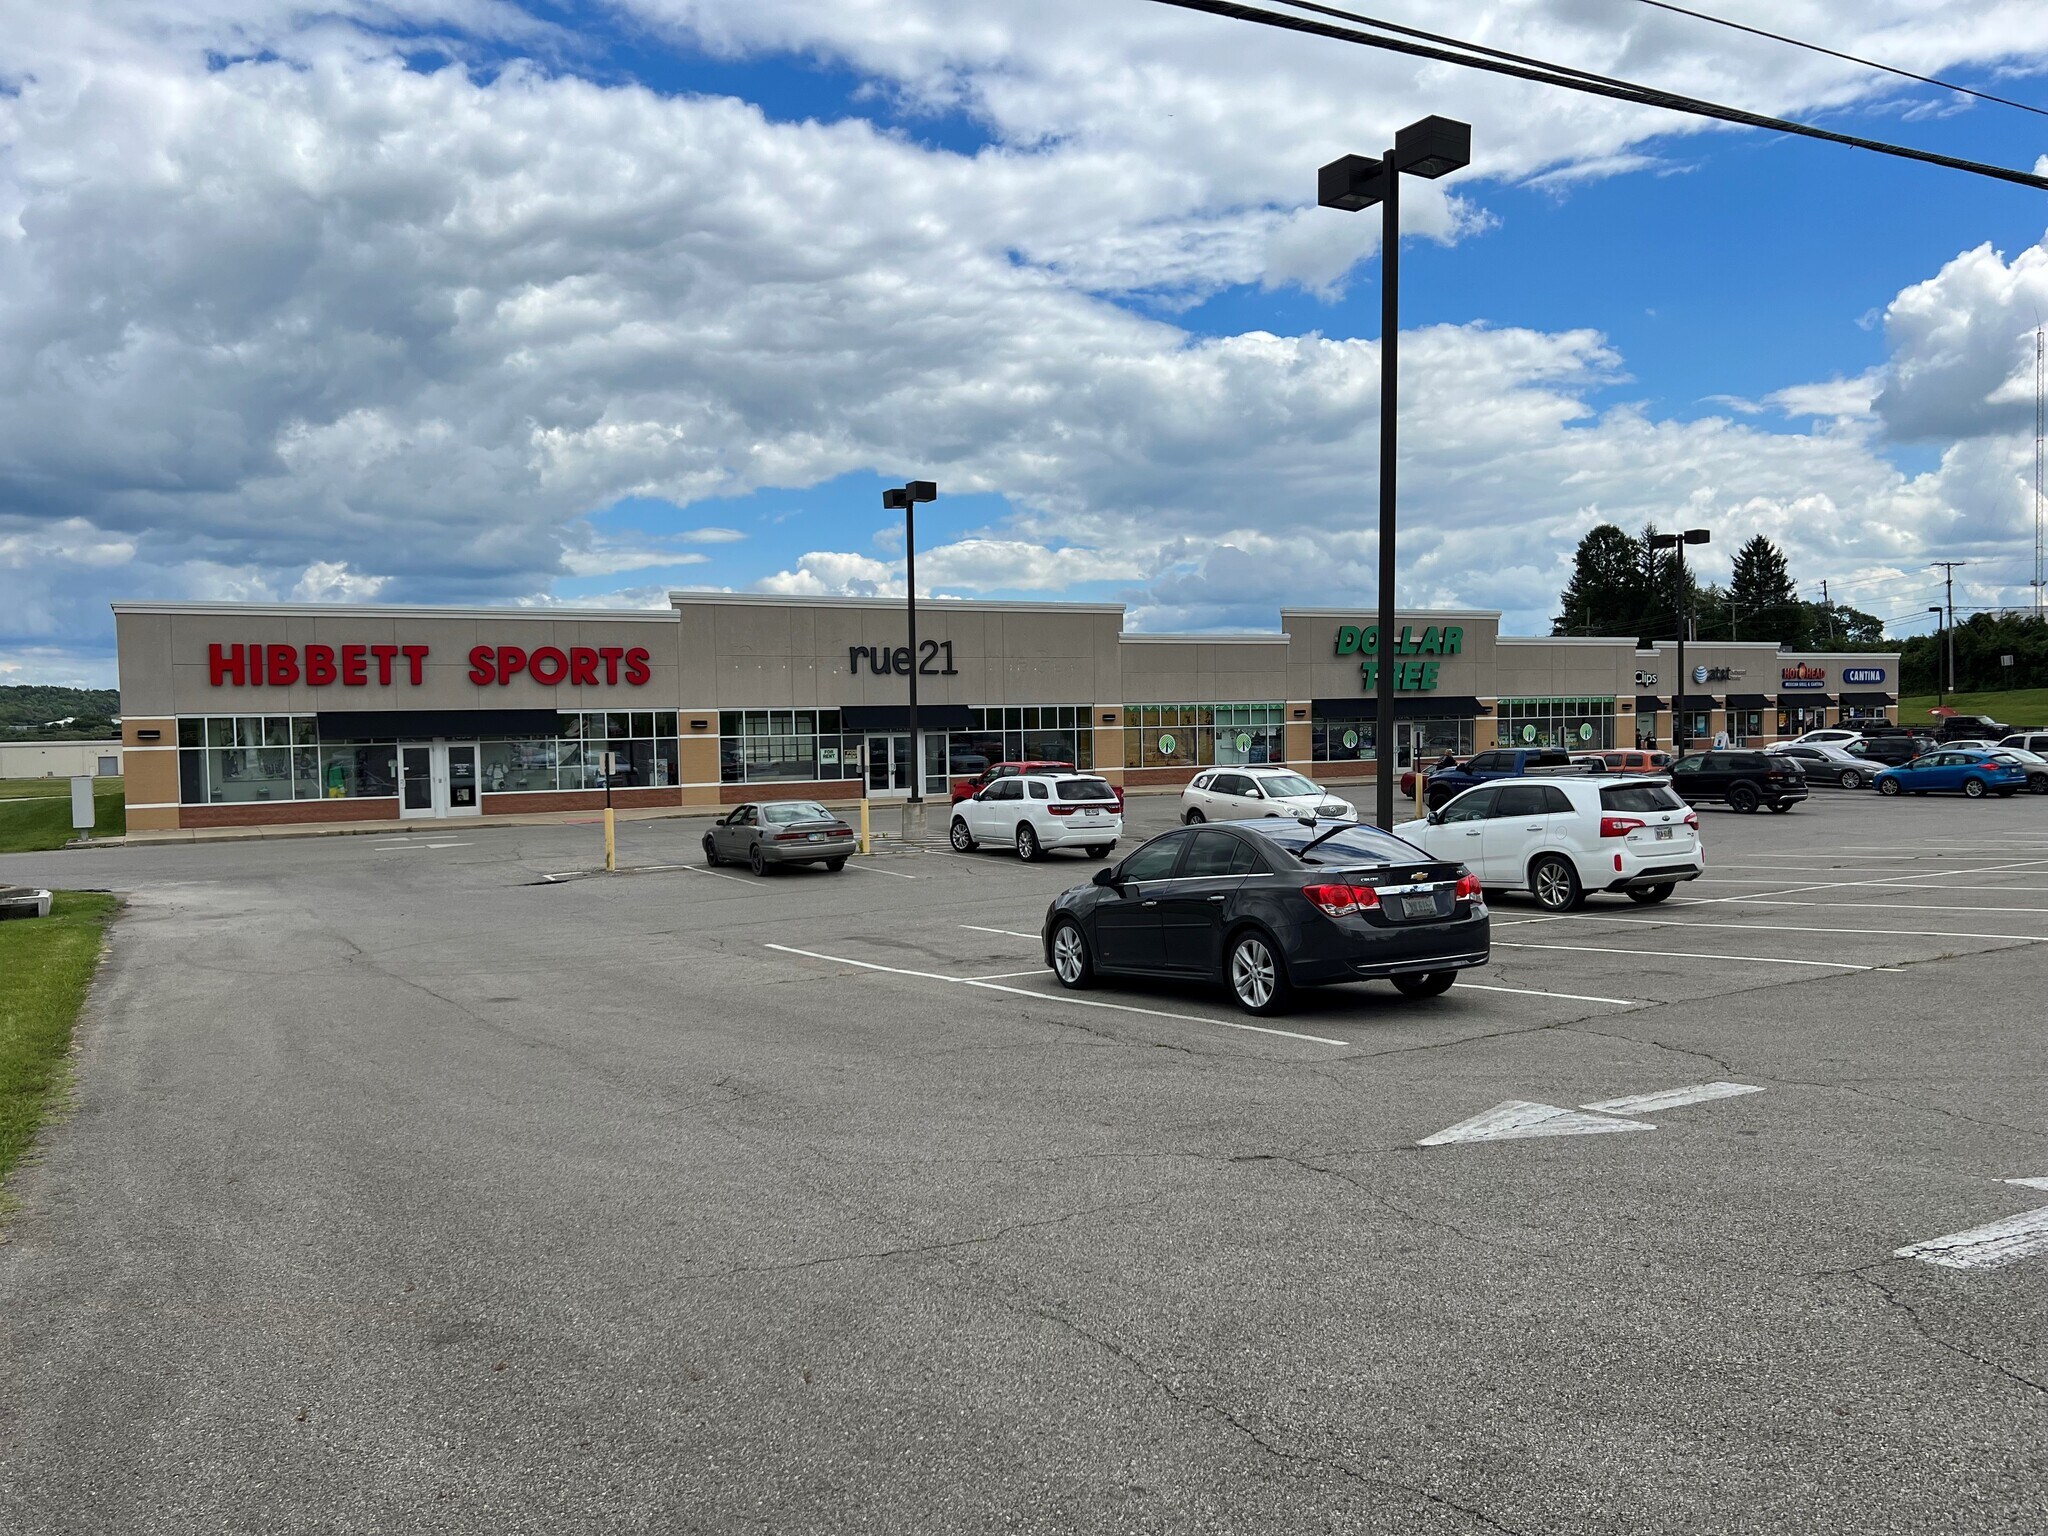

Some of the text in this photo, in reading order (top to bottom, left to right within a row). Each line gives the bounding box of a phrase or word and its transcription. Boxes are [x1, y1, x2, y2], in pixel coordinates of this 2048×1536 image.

[1336, 625, 1464, 655] DOLAR
[208, 643, 651, 687] HIBBETT SPORTS
[849, 639, 959, 675] rue21
[1635, 670, 1658, 687] Clips
[1783, 668, 1826, 680] HOT HEAD
[1849, 670, 1881, 682] CANTINA
